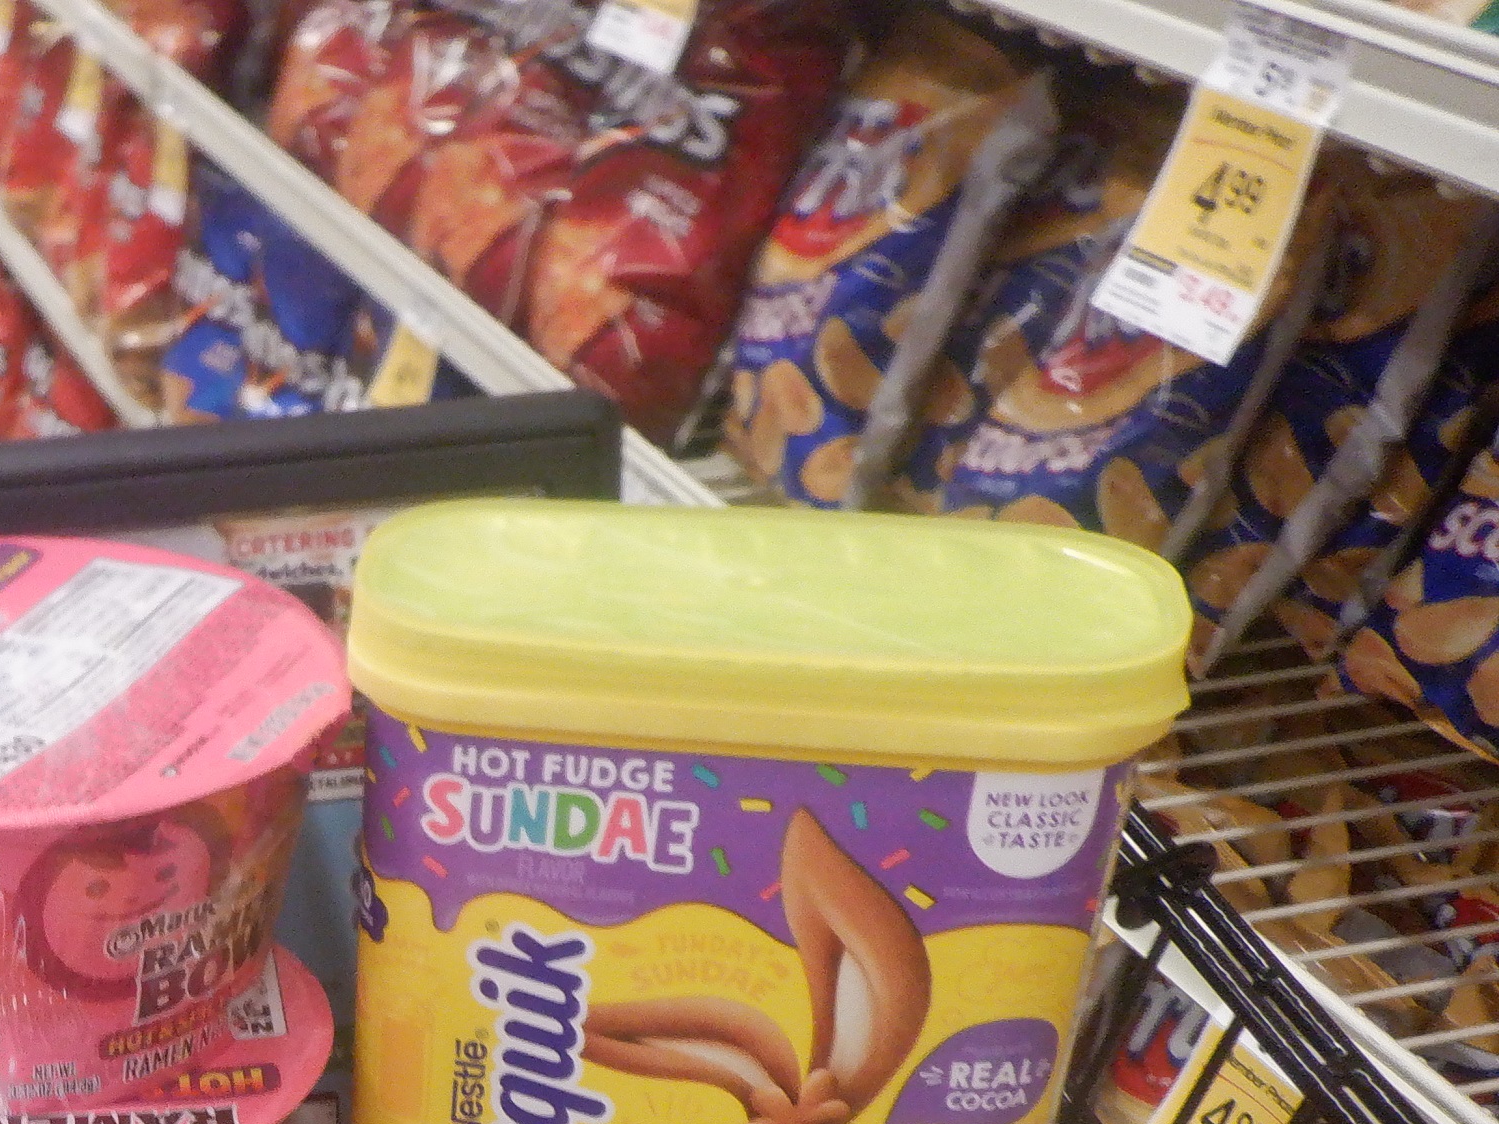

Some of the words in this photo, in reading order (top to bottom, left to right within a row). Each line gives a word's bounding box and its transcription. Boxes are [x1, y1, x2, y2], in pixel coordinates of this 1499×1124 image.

[451, 744, 531, 782] HOT
[541, 751, 677, 793] FUDGE
[985, 791, 1034, 808] NEW
[1039, 789, 1092, 808] LOOK
[420, 771, 701, 875] SUNDAE
[986, 809, 1084, 829] CLASSIC
[997, 829, 1068, 850] TASTE
[174, 1065, 266, 1097] HOT
[949, 1057, 1033, 1091] REAL
[945, 1087, 1028, 1112] COCOA
